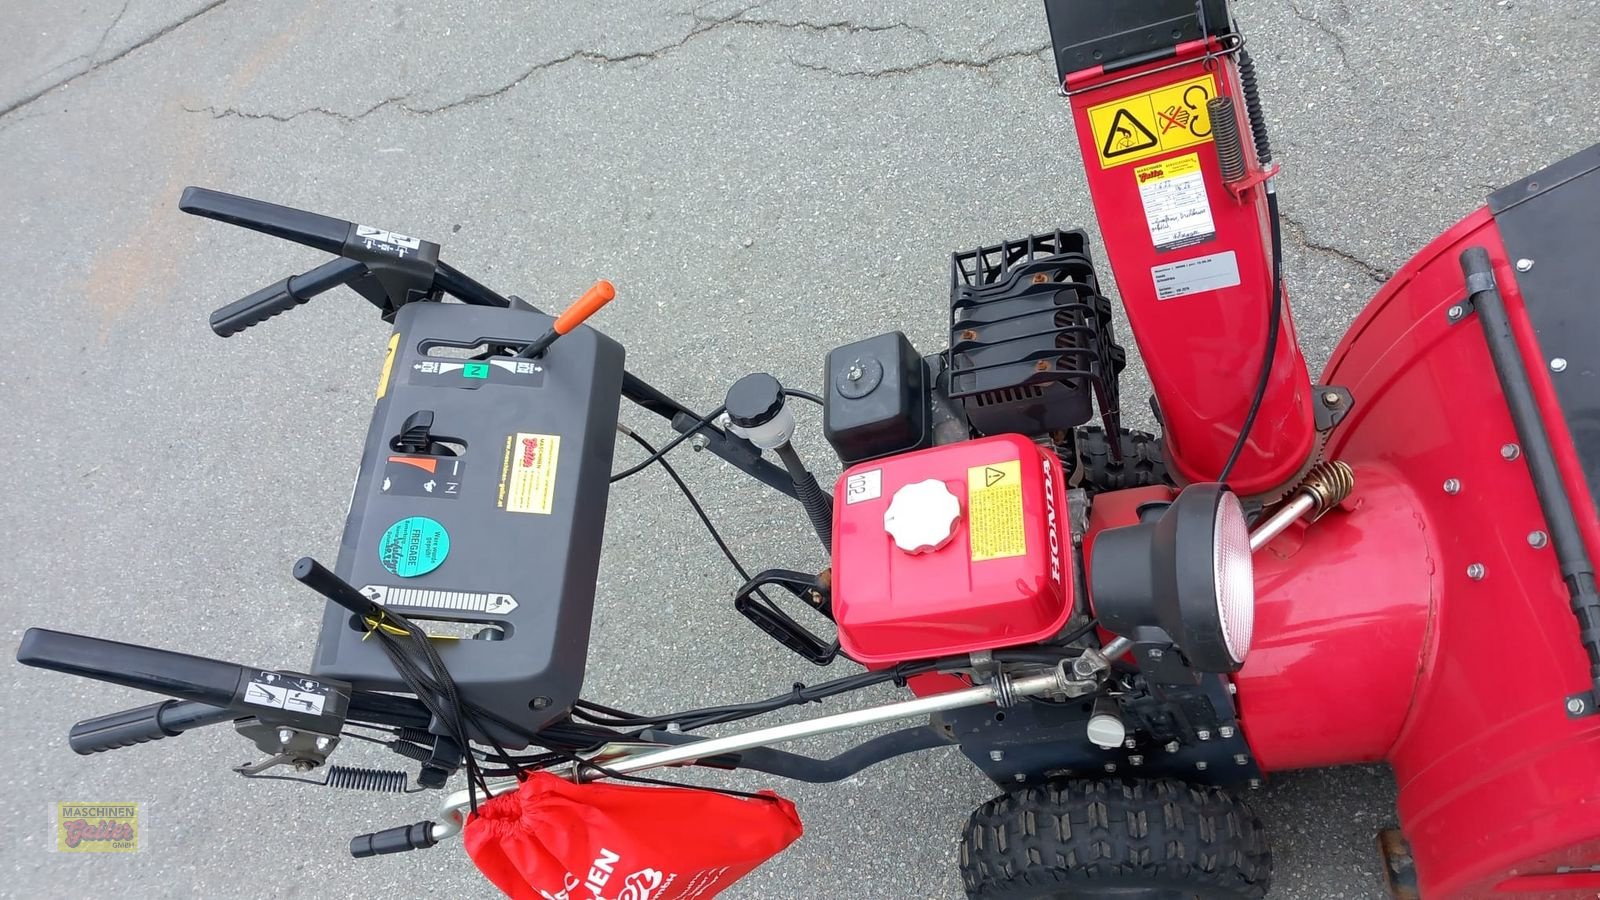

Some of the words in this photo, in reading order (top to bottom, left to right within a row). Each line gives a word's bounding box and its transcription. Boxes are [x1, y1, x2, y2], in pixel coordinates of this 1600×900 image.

[849, 475, 866, 496] 102
[1043, 458, 1061, 585] HONDA
[408, 528, 421, 567] FREIGABE
[433, 531, 441, 546] Ware
